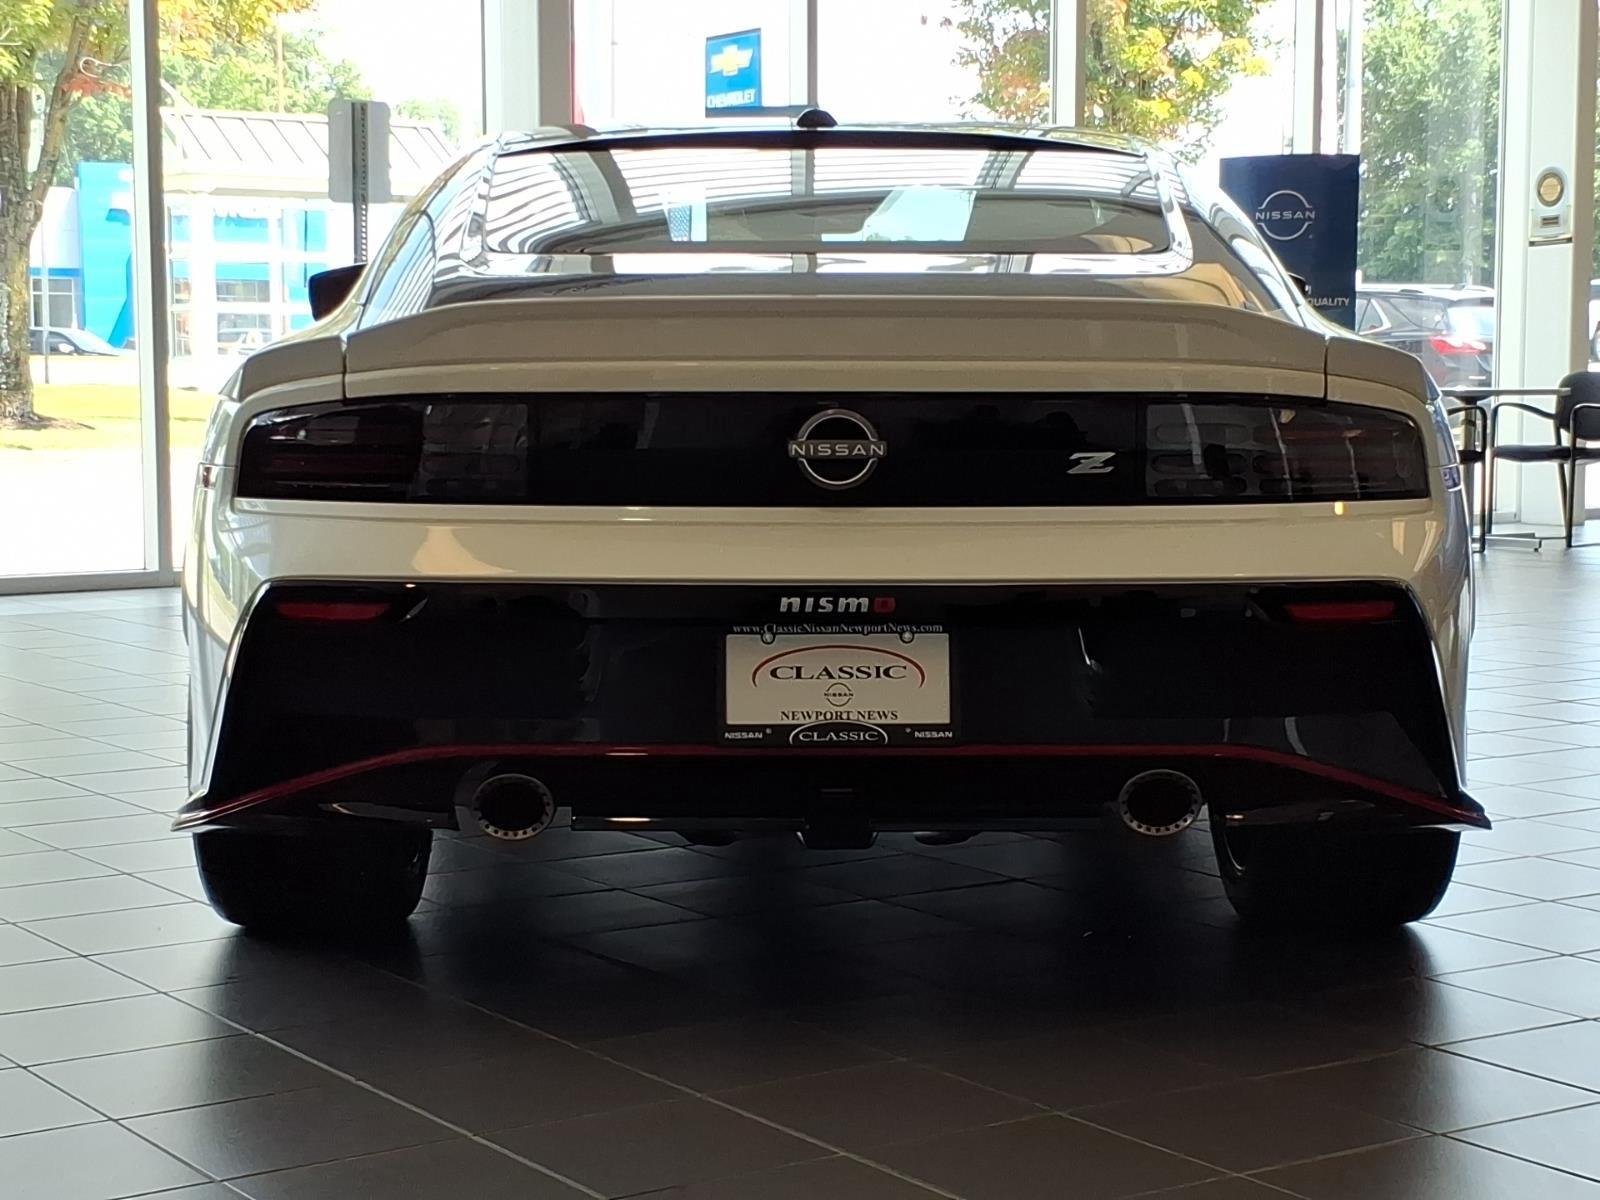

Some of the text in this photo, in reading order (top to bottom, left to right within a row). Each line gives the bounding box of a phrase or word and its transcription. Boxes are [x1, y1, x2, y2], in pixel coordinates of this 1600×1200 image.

[1255, 211, 1316, 220] NISSAN
[791, 443, 885, 456] NISSAN
[1066, 451, 1116, 475] Z
[779, 596, 896, 613] nismo
[732, 623, 943, 635] www.ClassicNissanNewportNews.com
[769, 665, 907, 680] CLASSIC
[780, 710, 898, 721] NEWPORT NEWS
[798, 731, 879, 742] CLASSIC
